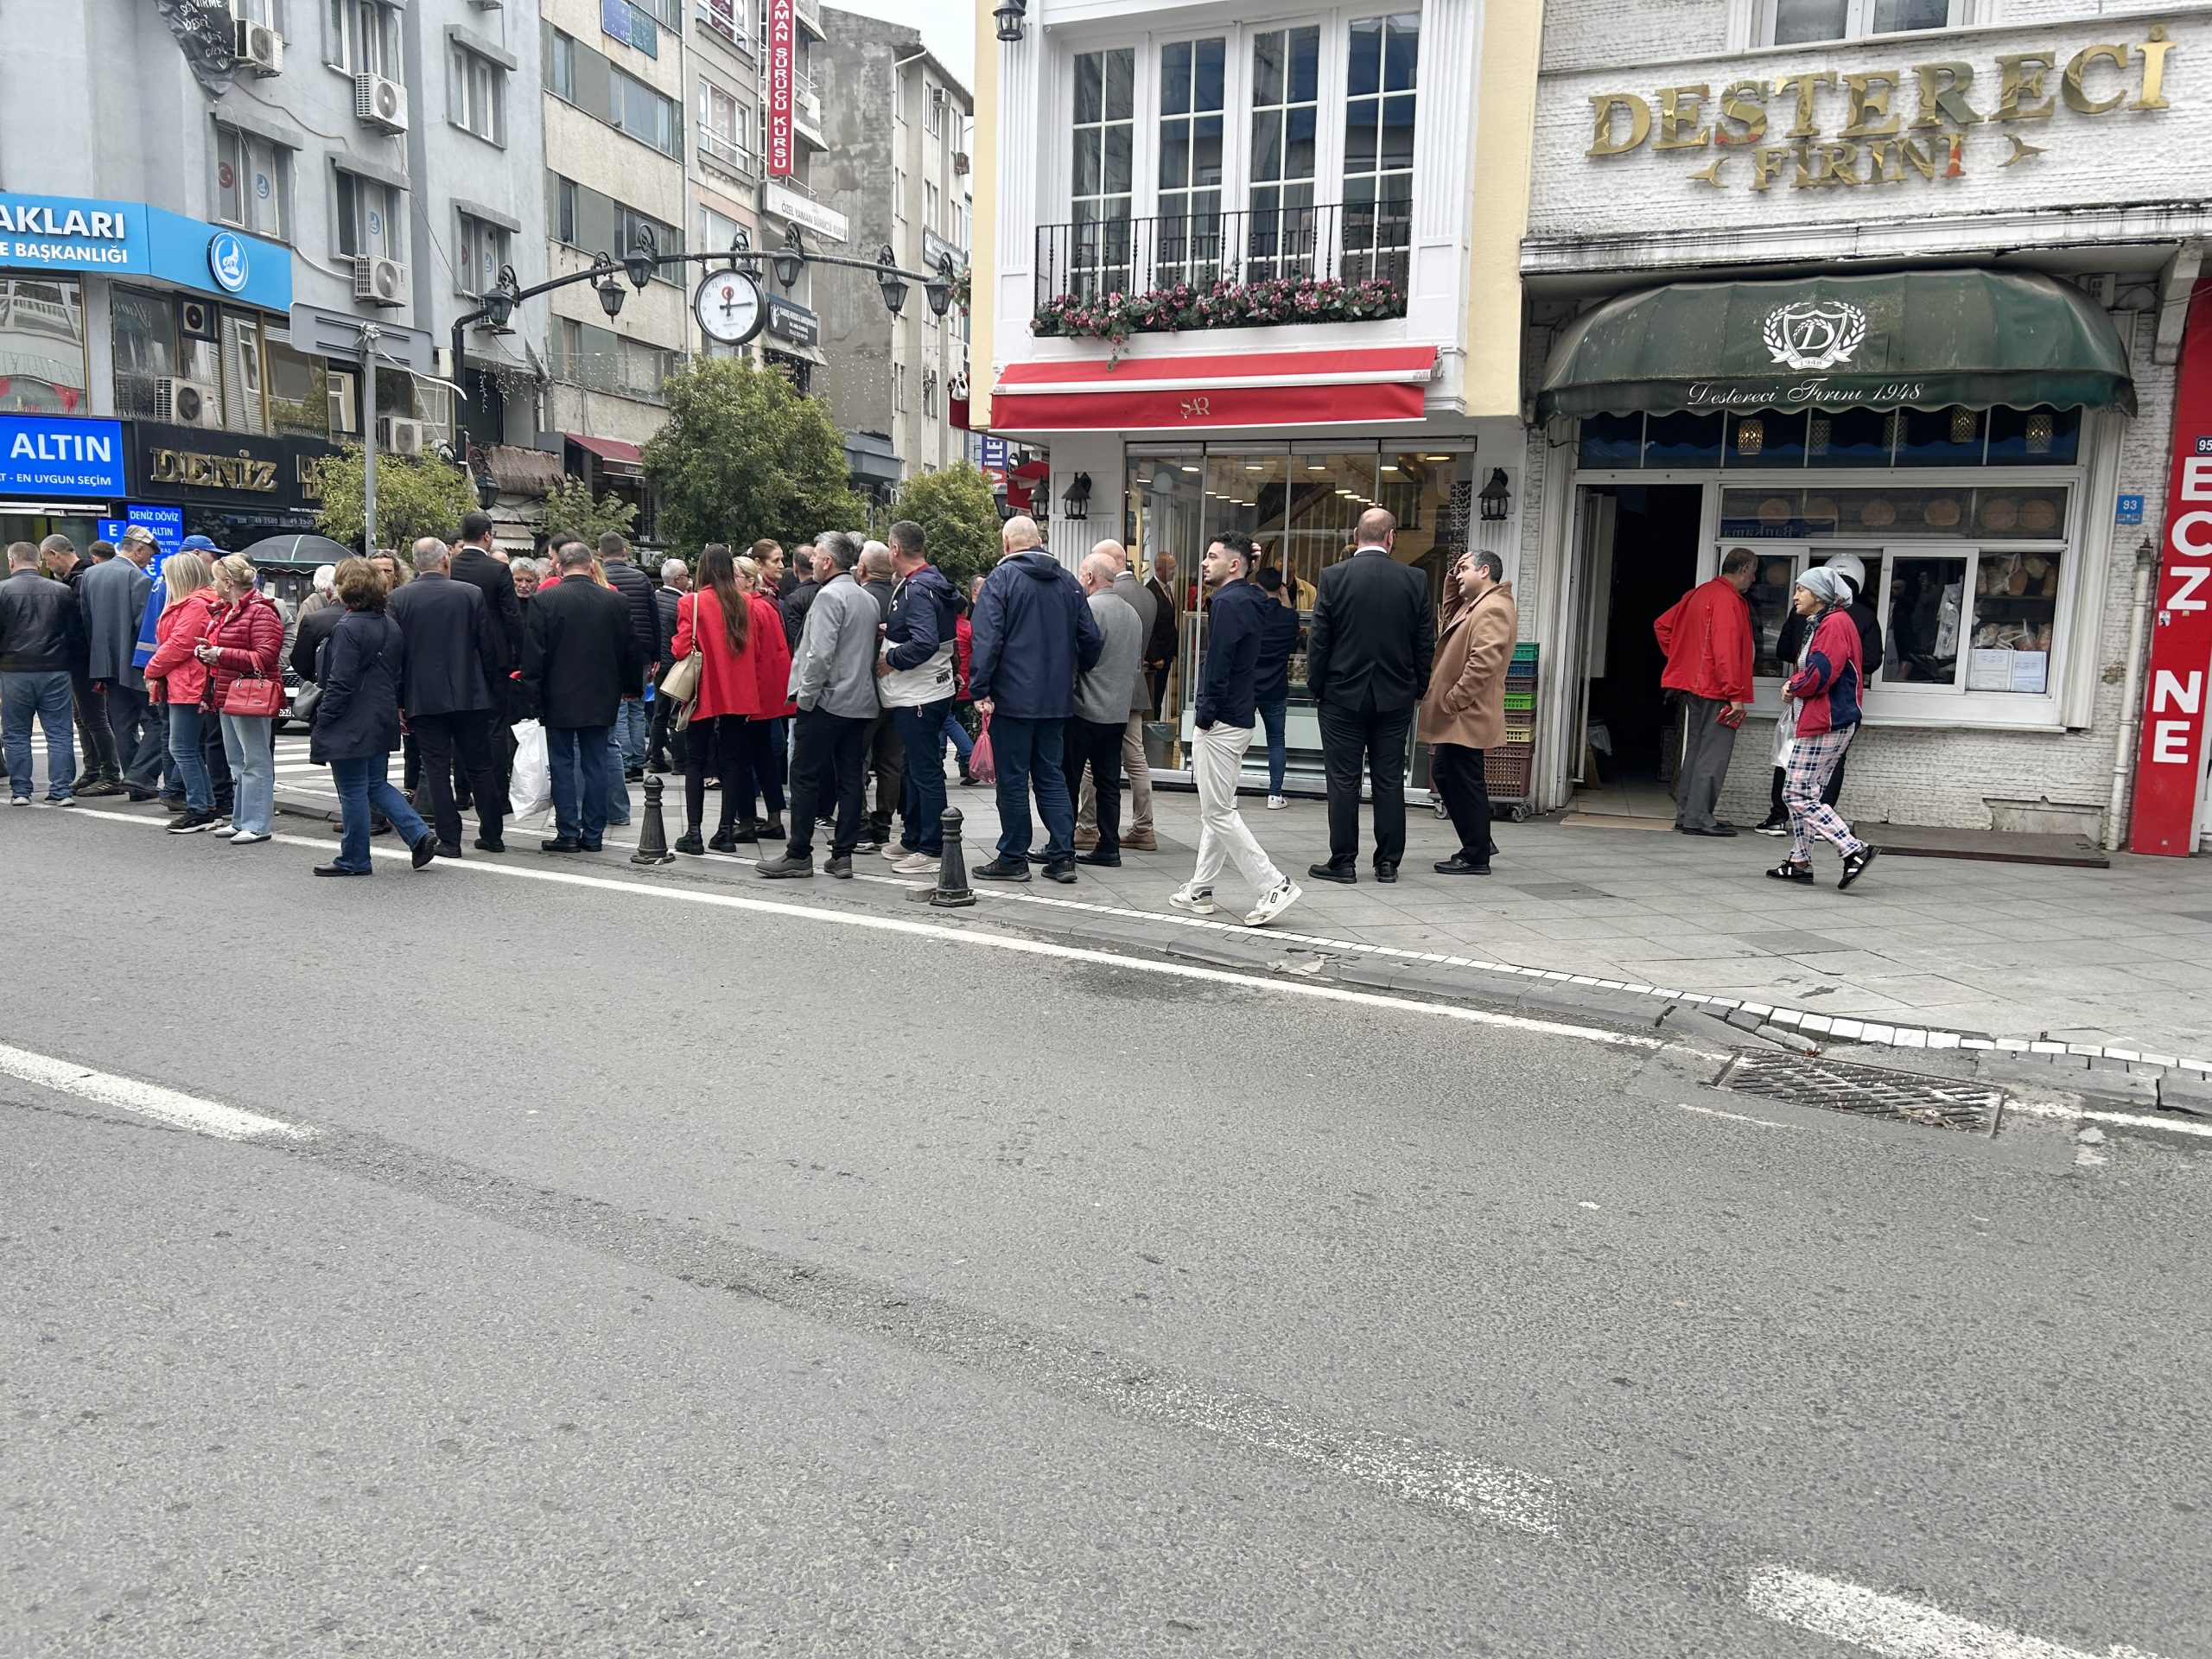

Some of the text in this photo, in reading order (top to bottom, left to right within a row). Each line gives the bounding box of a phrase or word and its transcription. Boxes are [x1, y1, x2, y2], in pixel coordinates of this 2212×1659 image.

[774, 48, 788, 111] SÜRÜCÜ
[1585, 24, 2176, 157] DESTERECİ
[773, 117, 787, 168] KURSU
[1749, 133, 1968, 191] FIRINI
[781, 200, 794, 216] ÖZEL
[794, 207, 813, 223] YAMAN
[15, 243, 128, 264] BAŞKANLIĞI
[1687, 381, 1779, 405] Destereci
[1872, 382, 1924, 400] 1948
[10, 432, 111, 462] ALTIN
[16, 474, 31, 483] EN
[35, 474, 74, 485] UYGUN
[78, 474, 111, 486] SEÇİM
[149, 447, 278, 493] DENİZ
[130, 508, 179, 522] DENİZ DÖVİZ
[2122, 500, 2138, 510] 93
[151, 526, 174, 537] ALTIN
